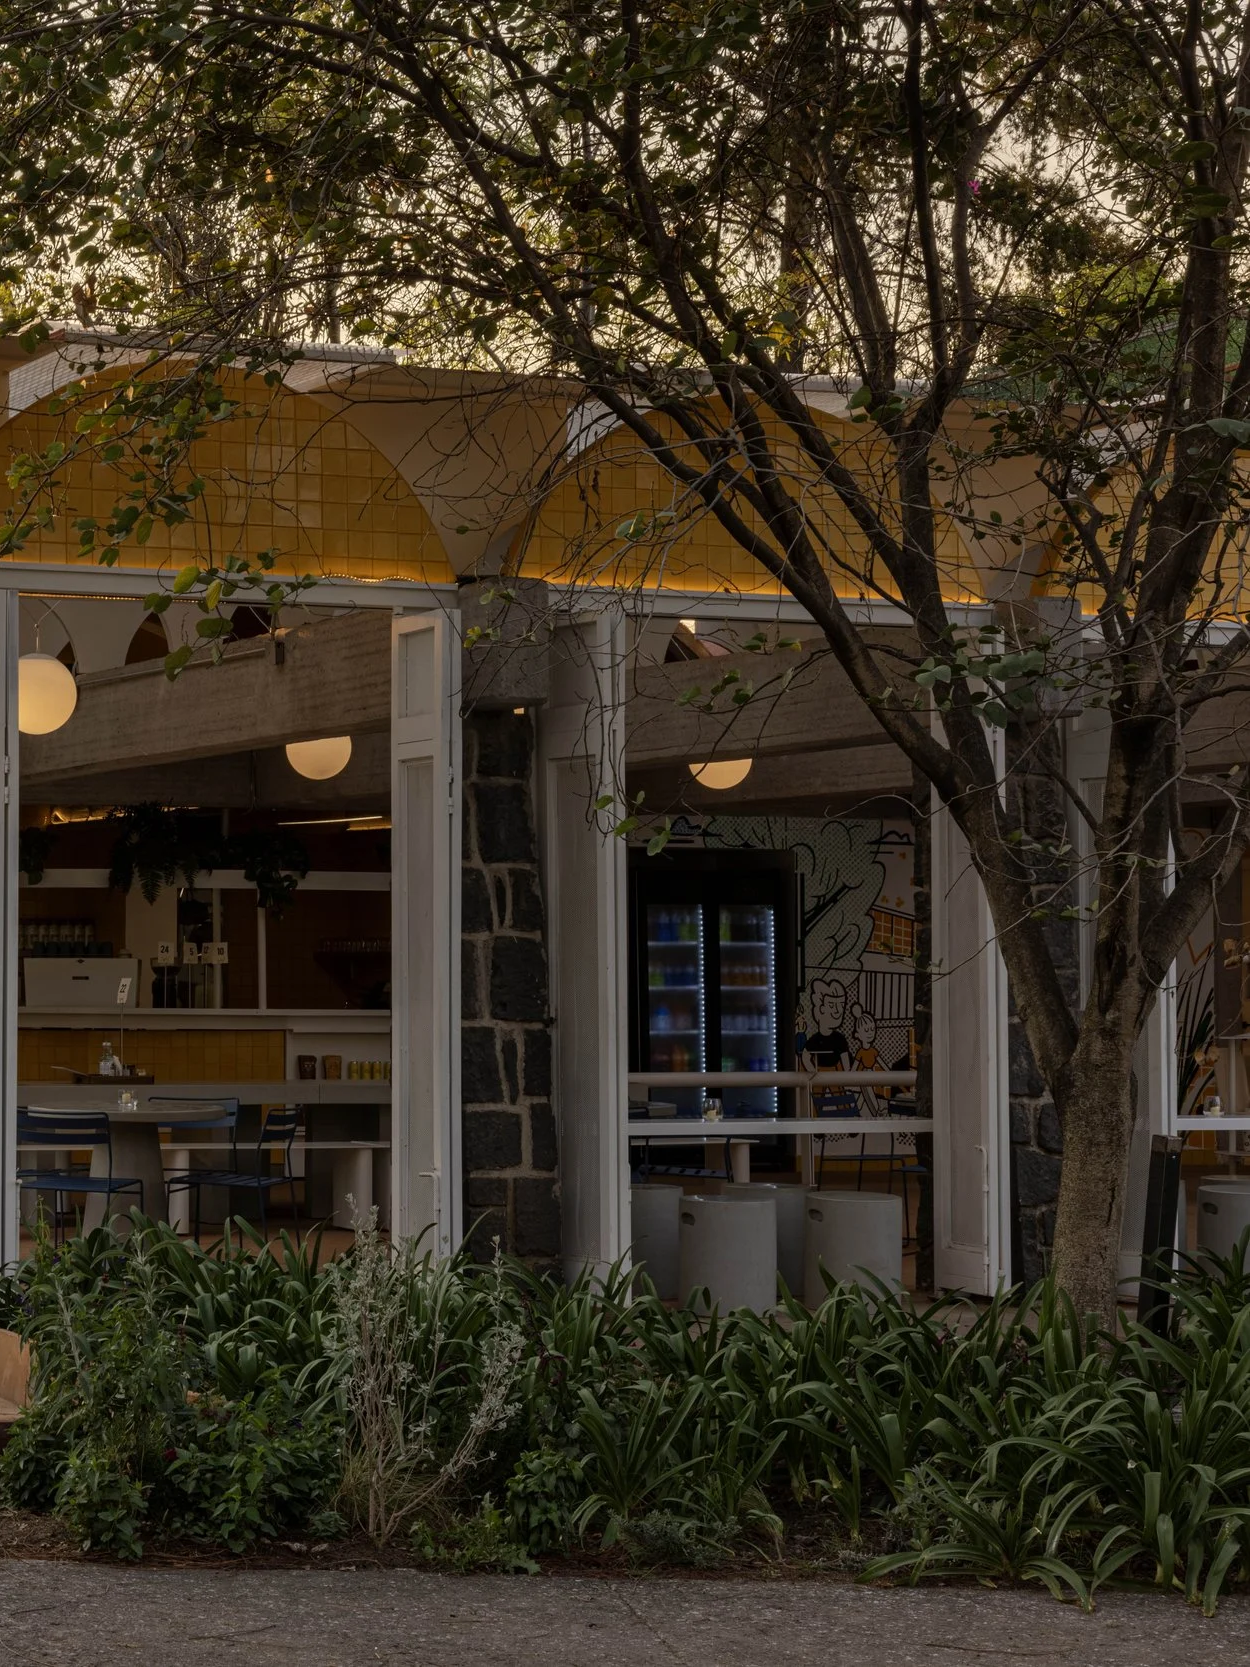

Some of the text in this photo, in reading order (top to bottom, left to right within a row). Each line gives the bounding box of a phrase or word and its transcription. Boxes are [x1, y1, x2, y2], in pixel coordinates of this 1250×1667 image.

[160, 945, 170, 954] 24
[189, 947, 194, 956] 5
[217, 946, 225, 956] 10
